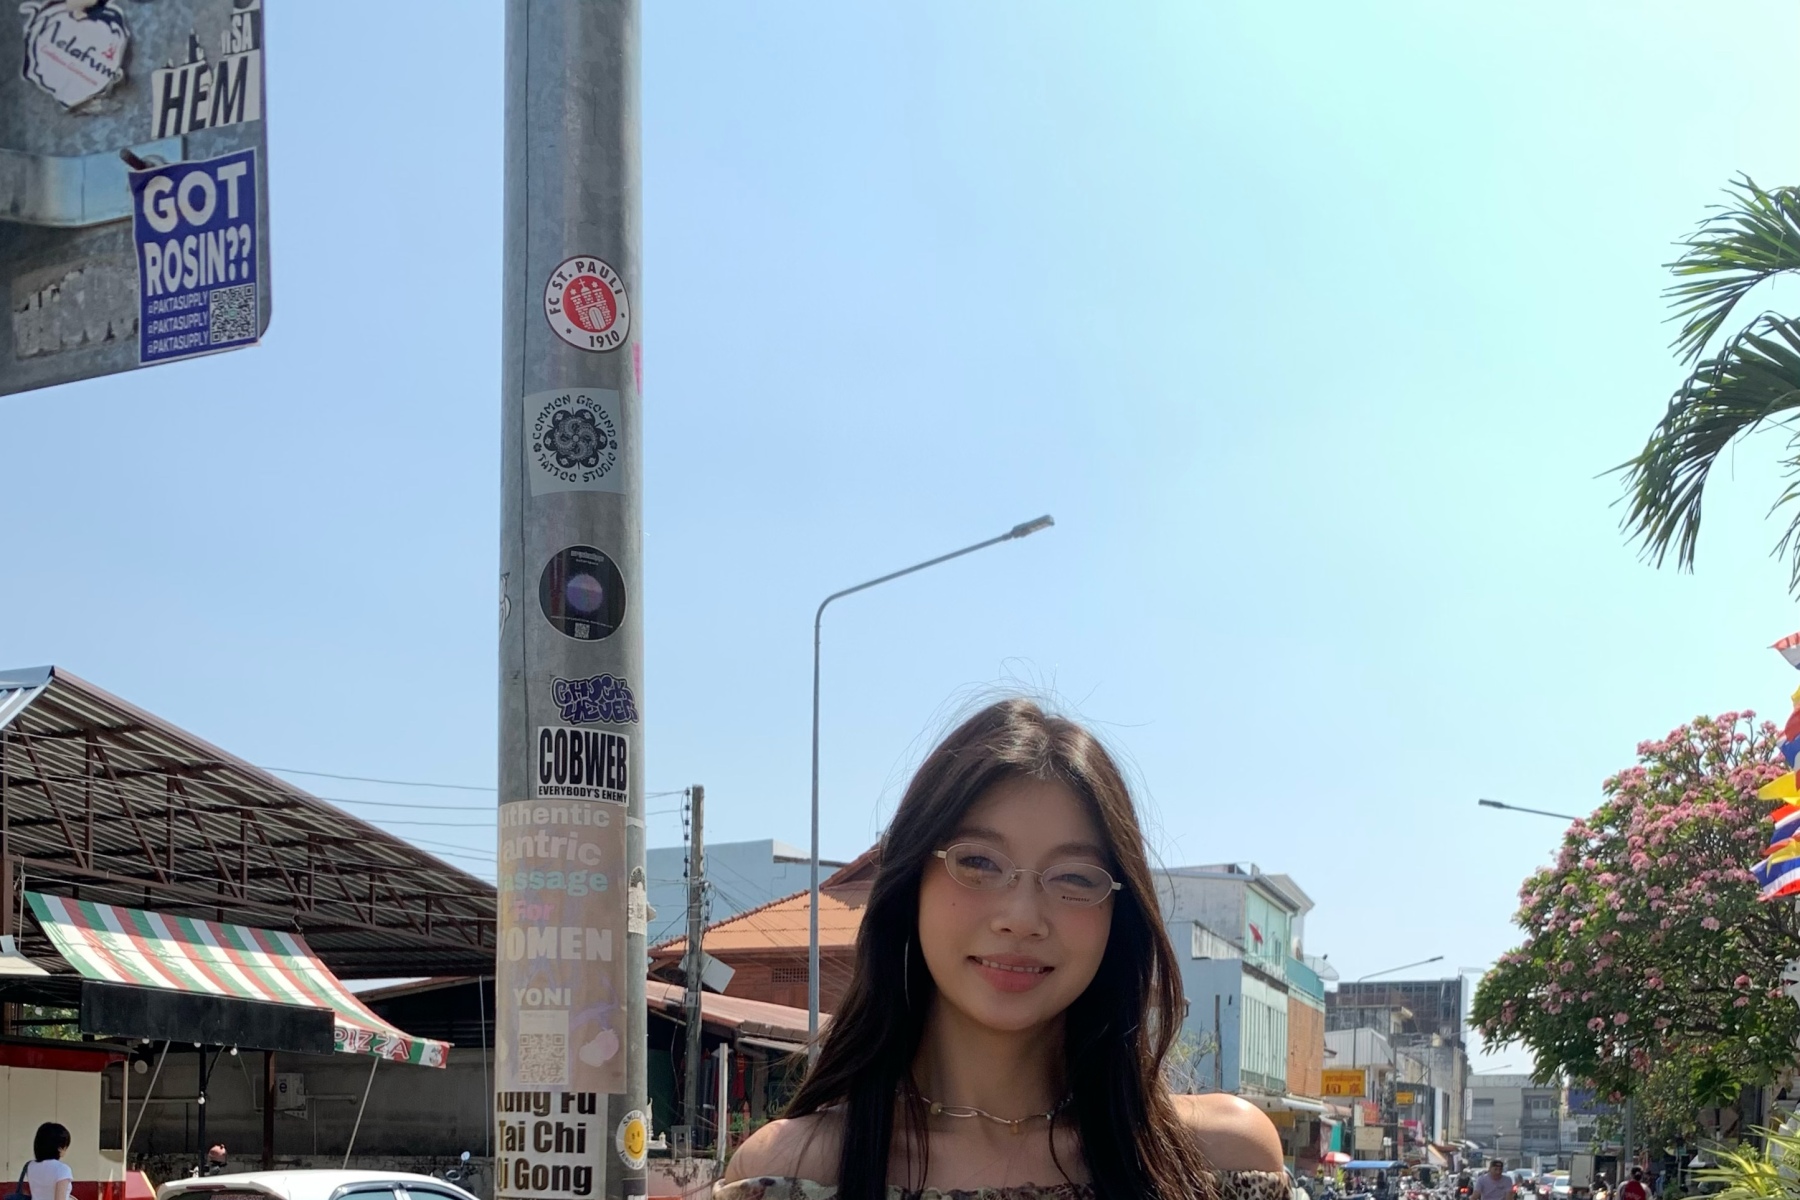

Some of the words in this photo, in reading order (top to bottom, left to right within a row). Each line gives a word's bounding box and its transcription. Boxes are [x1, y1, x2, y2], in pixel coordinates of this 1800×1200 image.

[143, 161, 247, 233] GOT
[143, 223, 252, 297] ROSIN??
[552, 270, 573, 290] ST.
[575, 261, 623, 295] PAULI
[548, 298, 561, 315] FC
[589, 330, 620, 347] 1910
[532, 394, 571, 439] COMMON
[576, 395, 616, 437] GROUND
[538, 453, 577, 482] TATTOO
[582, 452, 616, 482] STUDIO
[540, 728, 627, 791] COBWEB
[538, 786, 600, 799] EVERYBODY'S
[602, 789, 628, 803] ENEMY
[513, 987, 571, 1006] YONI
[334, 1026, 410, 1060] PIZZA
[499, 1120, 526, 1152] Tai
[533, 1120, 586, 1154] Chi
[514, 1158, 592, 1196] Gong
